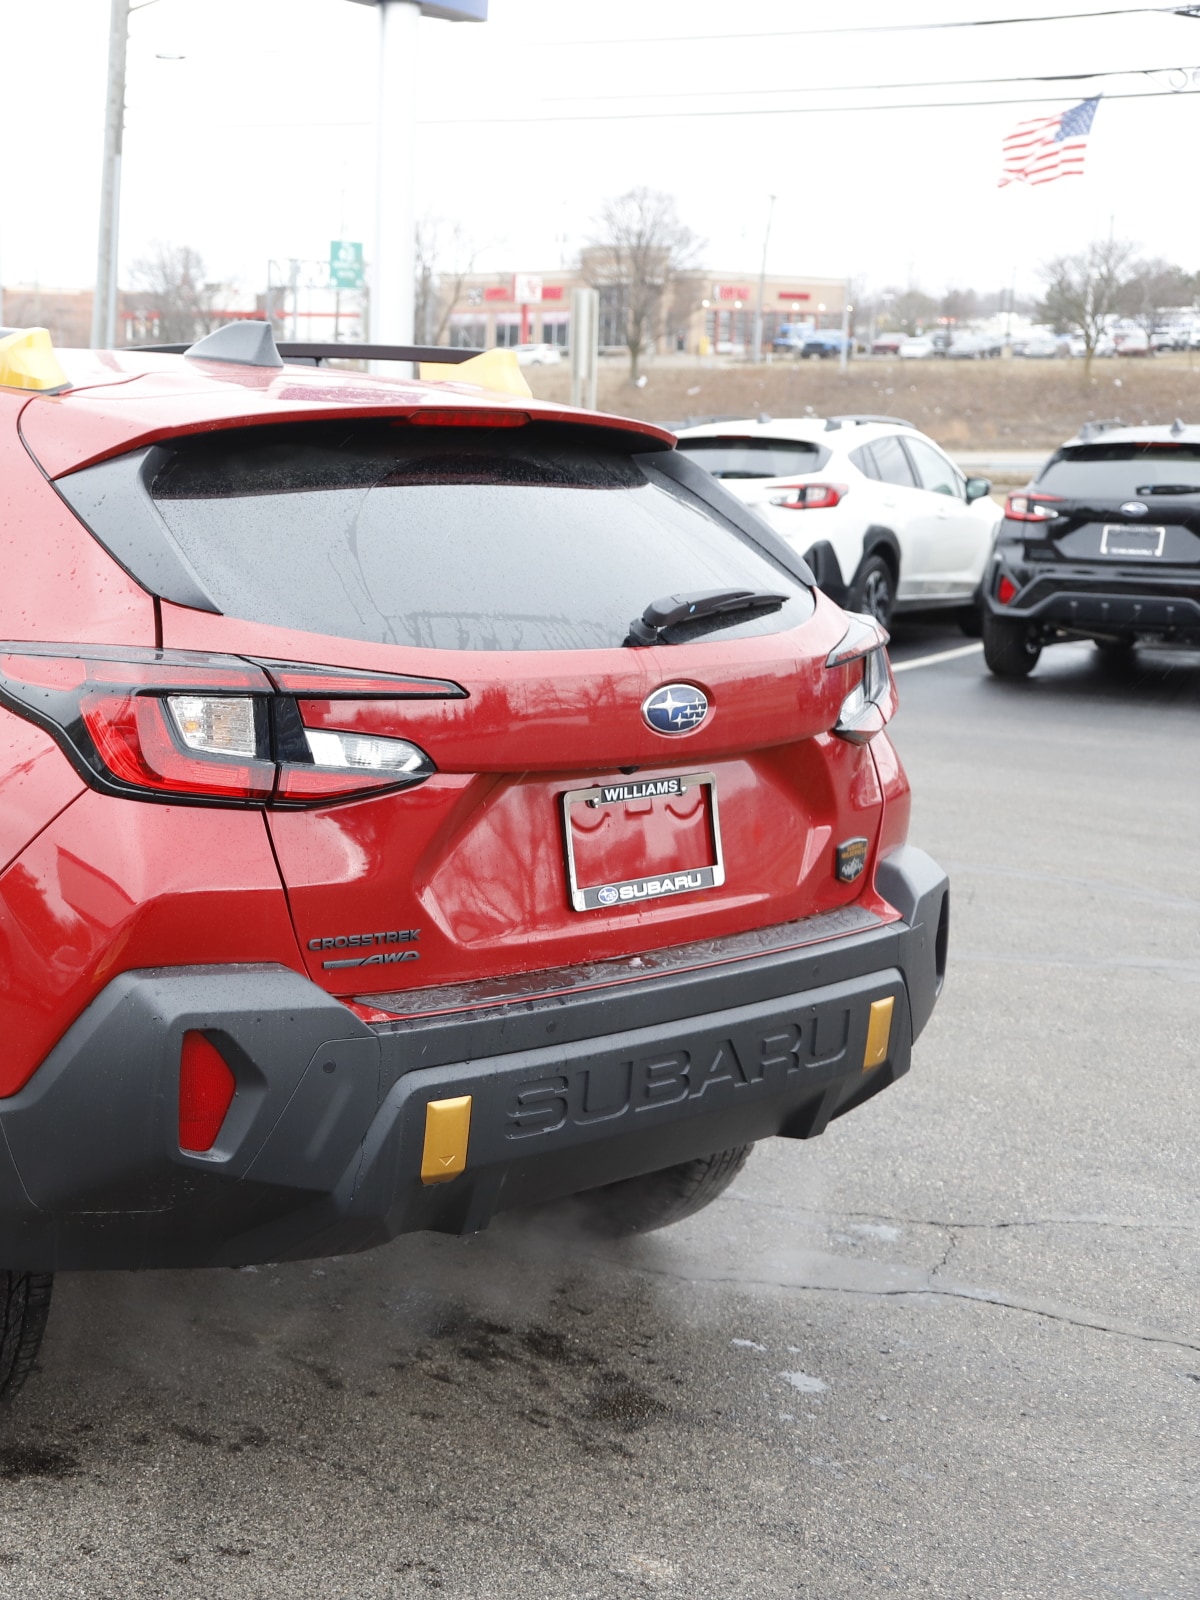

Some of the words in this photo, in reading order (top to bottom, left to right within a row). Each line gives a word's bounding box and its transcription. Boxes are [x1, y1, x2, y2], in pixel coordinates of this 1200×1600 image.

[604, 780, 678, 801] WILLIAMS
[619, 873, 702, 900] SUBARU
[308, 928, 421, 951] CROSSTREK
[360, 950, 420, 966] AWD
[505, 1009, 851, 1140] SUBARU
